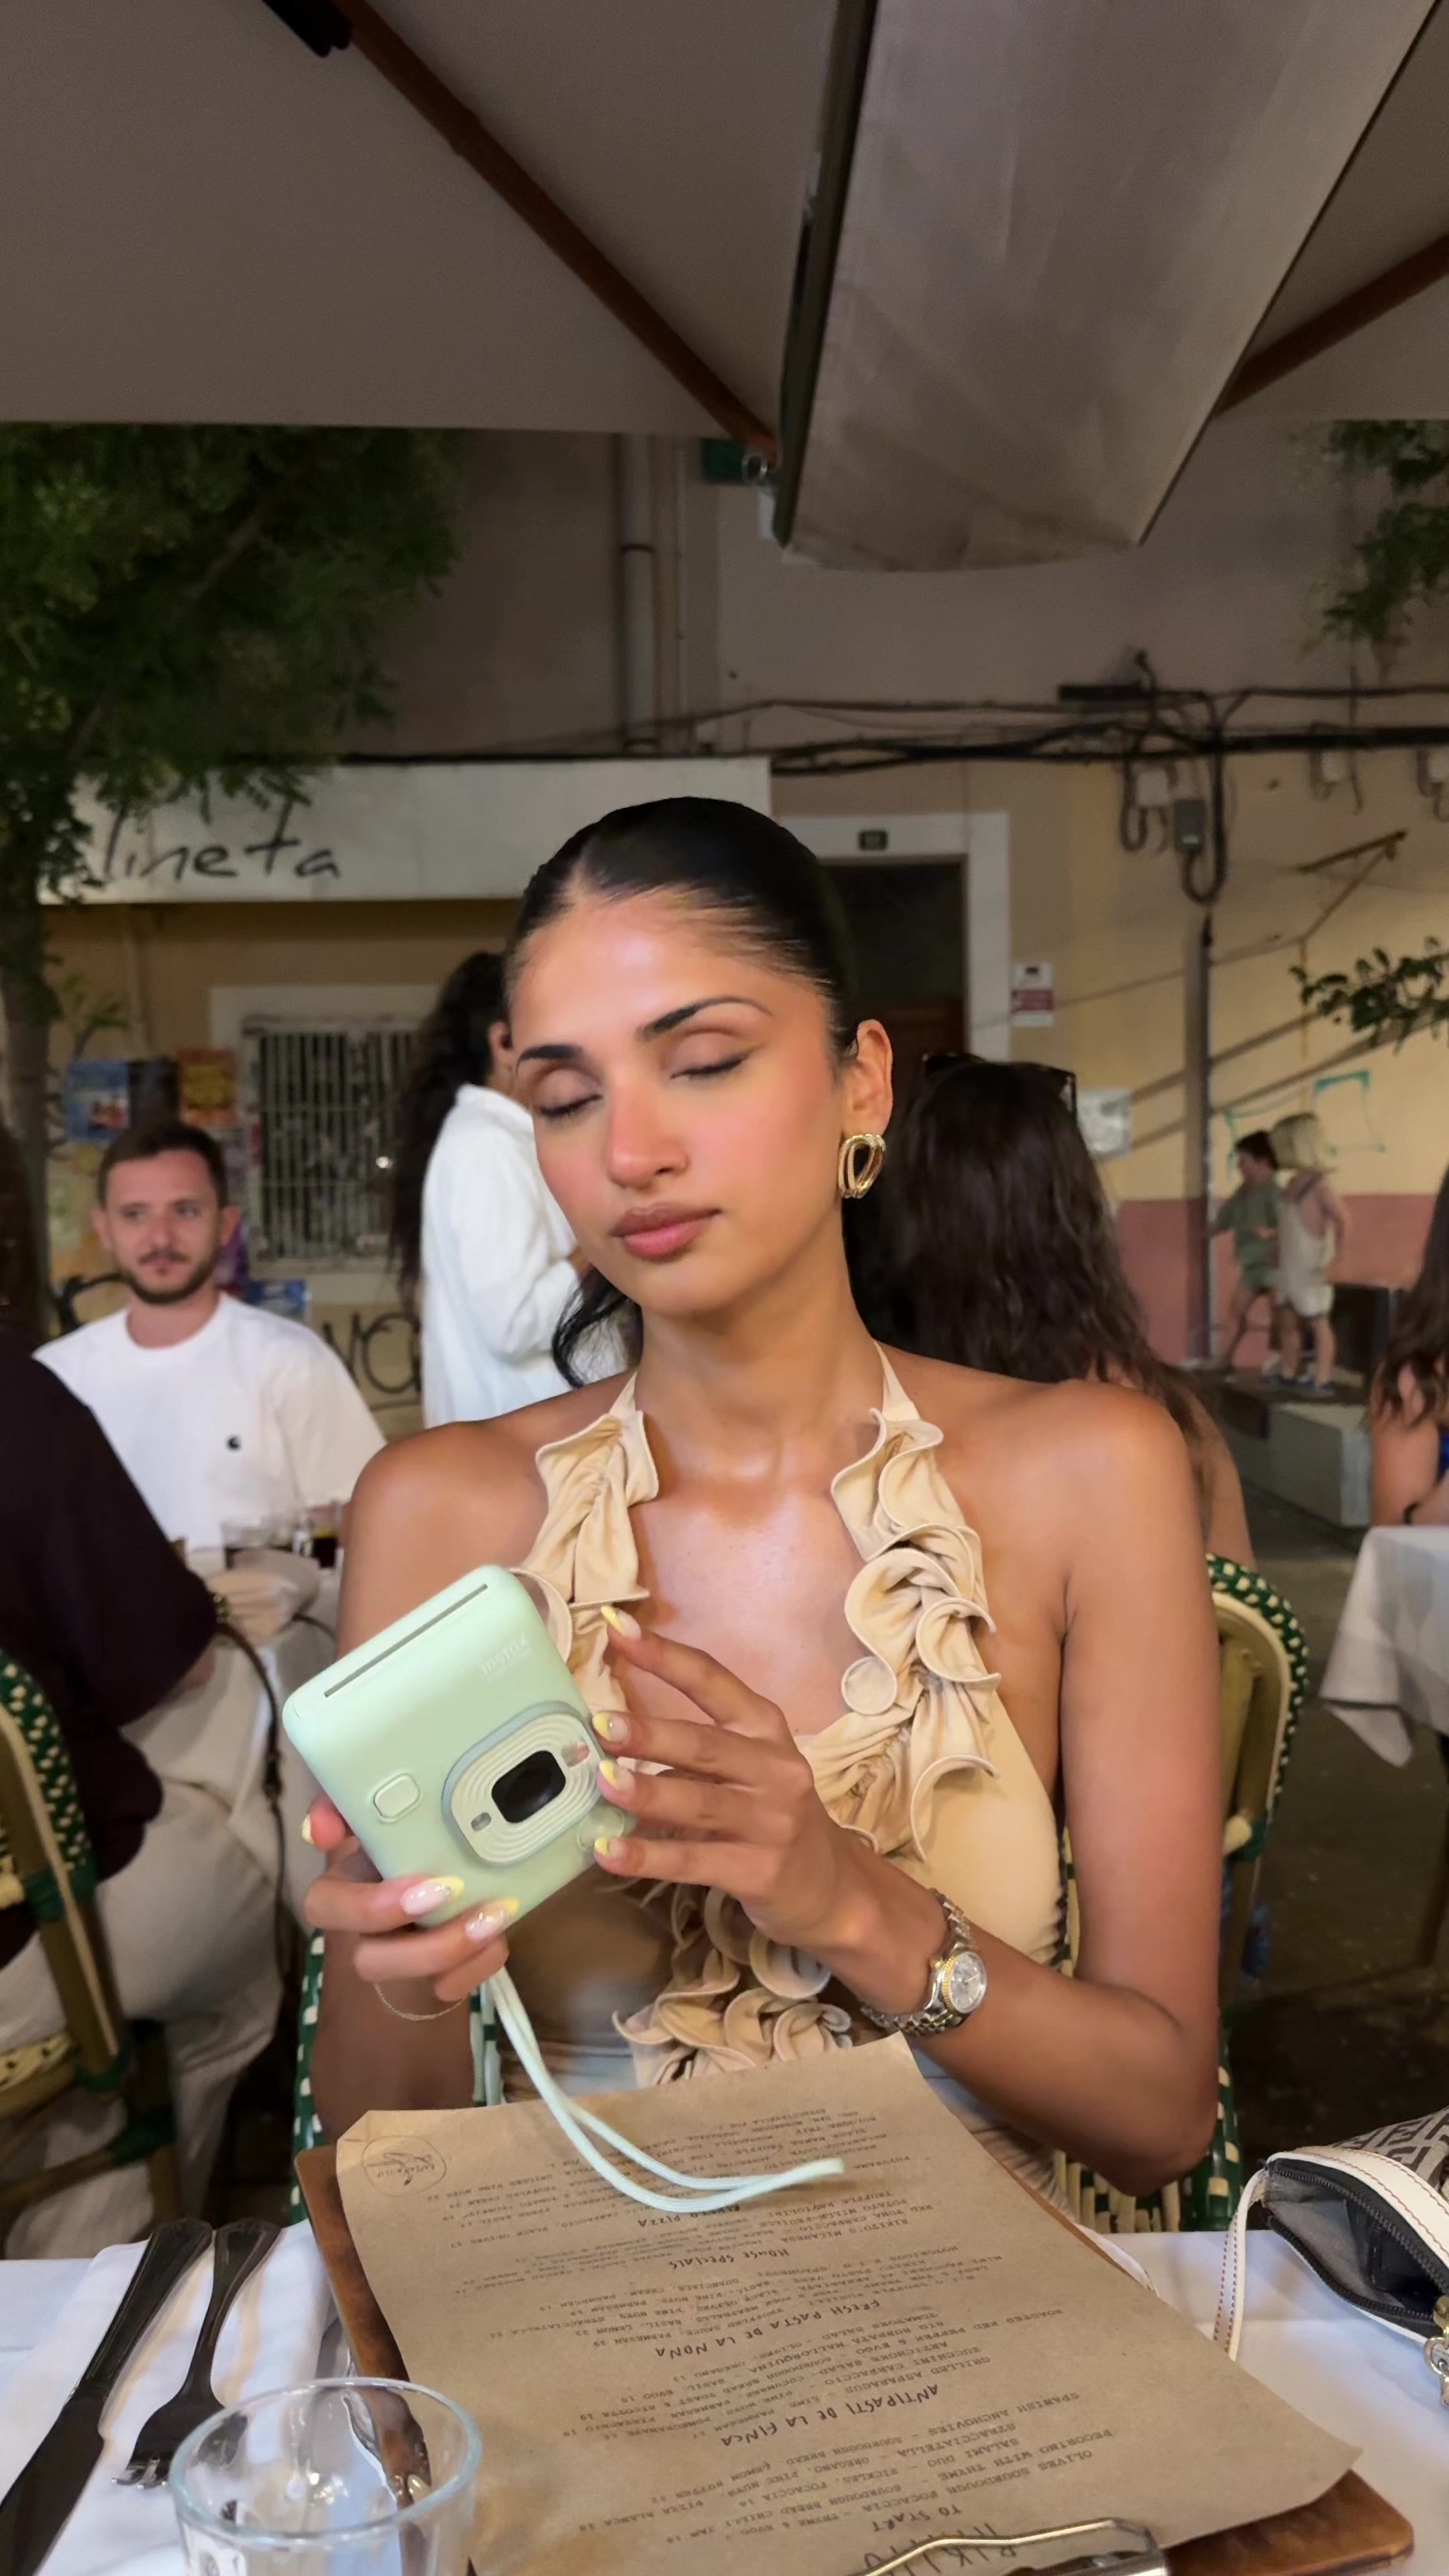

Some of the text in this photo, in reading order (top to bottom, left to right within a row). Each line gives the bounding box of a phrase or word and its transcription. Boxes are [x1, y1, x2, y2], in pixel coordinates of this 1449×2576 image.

[638, 2214, 681, 2227] PIZZA
[669, 2249, 790, 2269] HOUSE SPECIALS
[655, 2299, 879, 2359] FRESH PASTA DE LA NONA
[822, 2326, 864, 2341] SALAD
[973, 2321, 998, 2330] RED
[856, 2343, 890, 2355] EVOO
[871, 2341, 948, 2363] ARTICHOKE
[912, 2347, 981, 2366] ZUCCHINI
[824, 2363, 904, 2385] CARPACCIO
[930, 2357, 990, 2374] GRILLED
[845, 2371, 922, 2393] ASPARAGUS
[1016, 2393, 1079, 2413] SPANISH
[721, 2384, 937, 2448] ANTIPASTI DE LA FINCA
[928, 2410, 1009, 2436] ANCHOVIES
[832, 2436, 903, 2455] SOURDOUGH
[896, 2423, 1016, 2457] STRACCIATELLA
[965, 2438, 1019, 2458] SALAMI
[1039, 2430, 1114, 2453] PECORINO
[927, 2455, 955, 2467] DUO
[994, 2451, 1032, 2467] WITH
[1038, 2451, 1092, 2471] OLIVES
[766, 2470, 799, 2485] PINE
[938, 2464, 986, 2481] THYME
[946, 2467, 1030, 2494] SOURDOUGH
[761, 2481, 828, 2501] FOCACCIA
[828, 2484, 902, 2506] SOURDOUGH
[780, 2502, 822, 2515] BREAD
[872, 2504, 961, 2532] TO START
[726, 2511, 773, 2527] CHILLI
